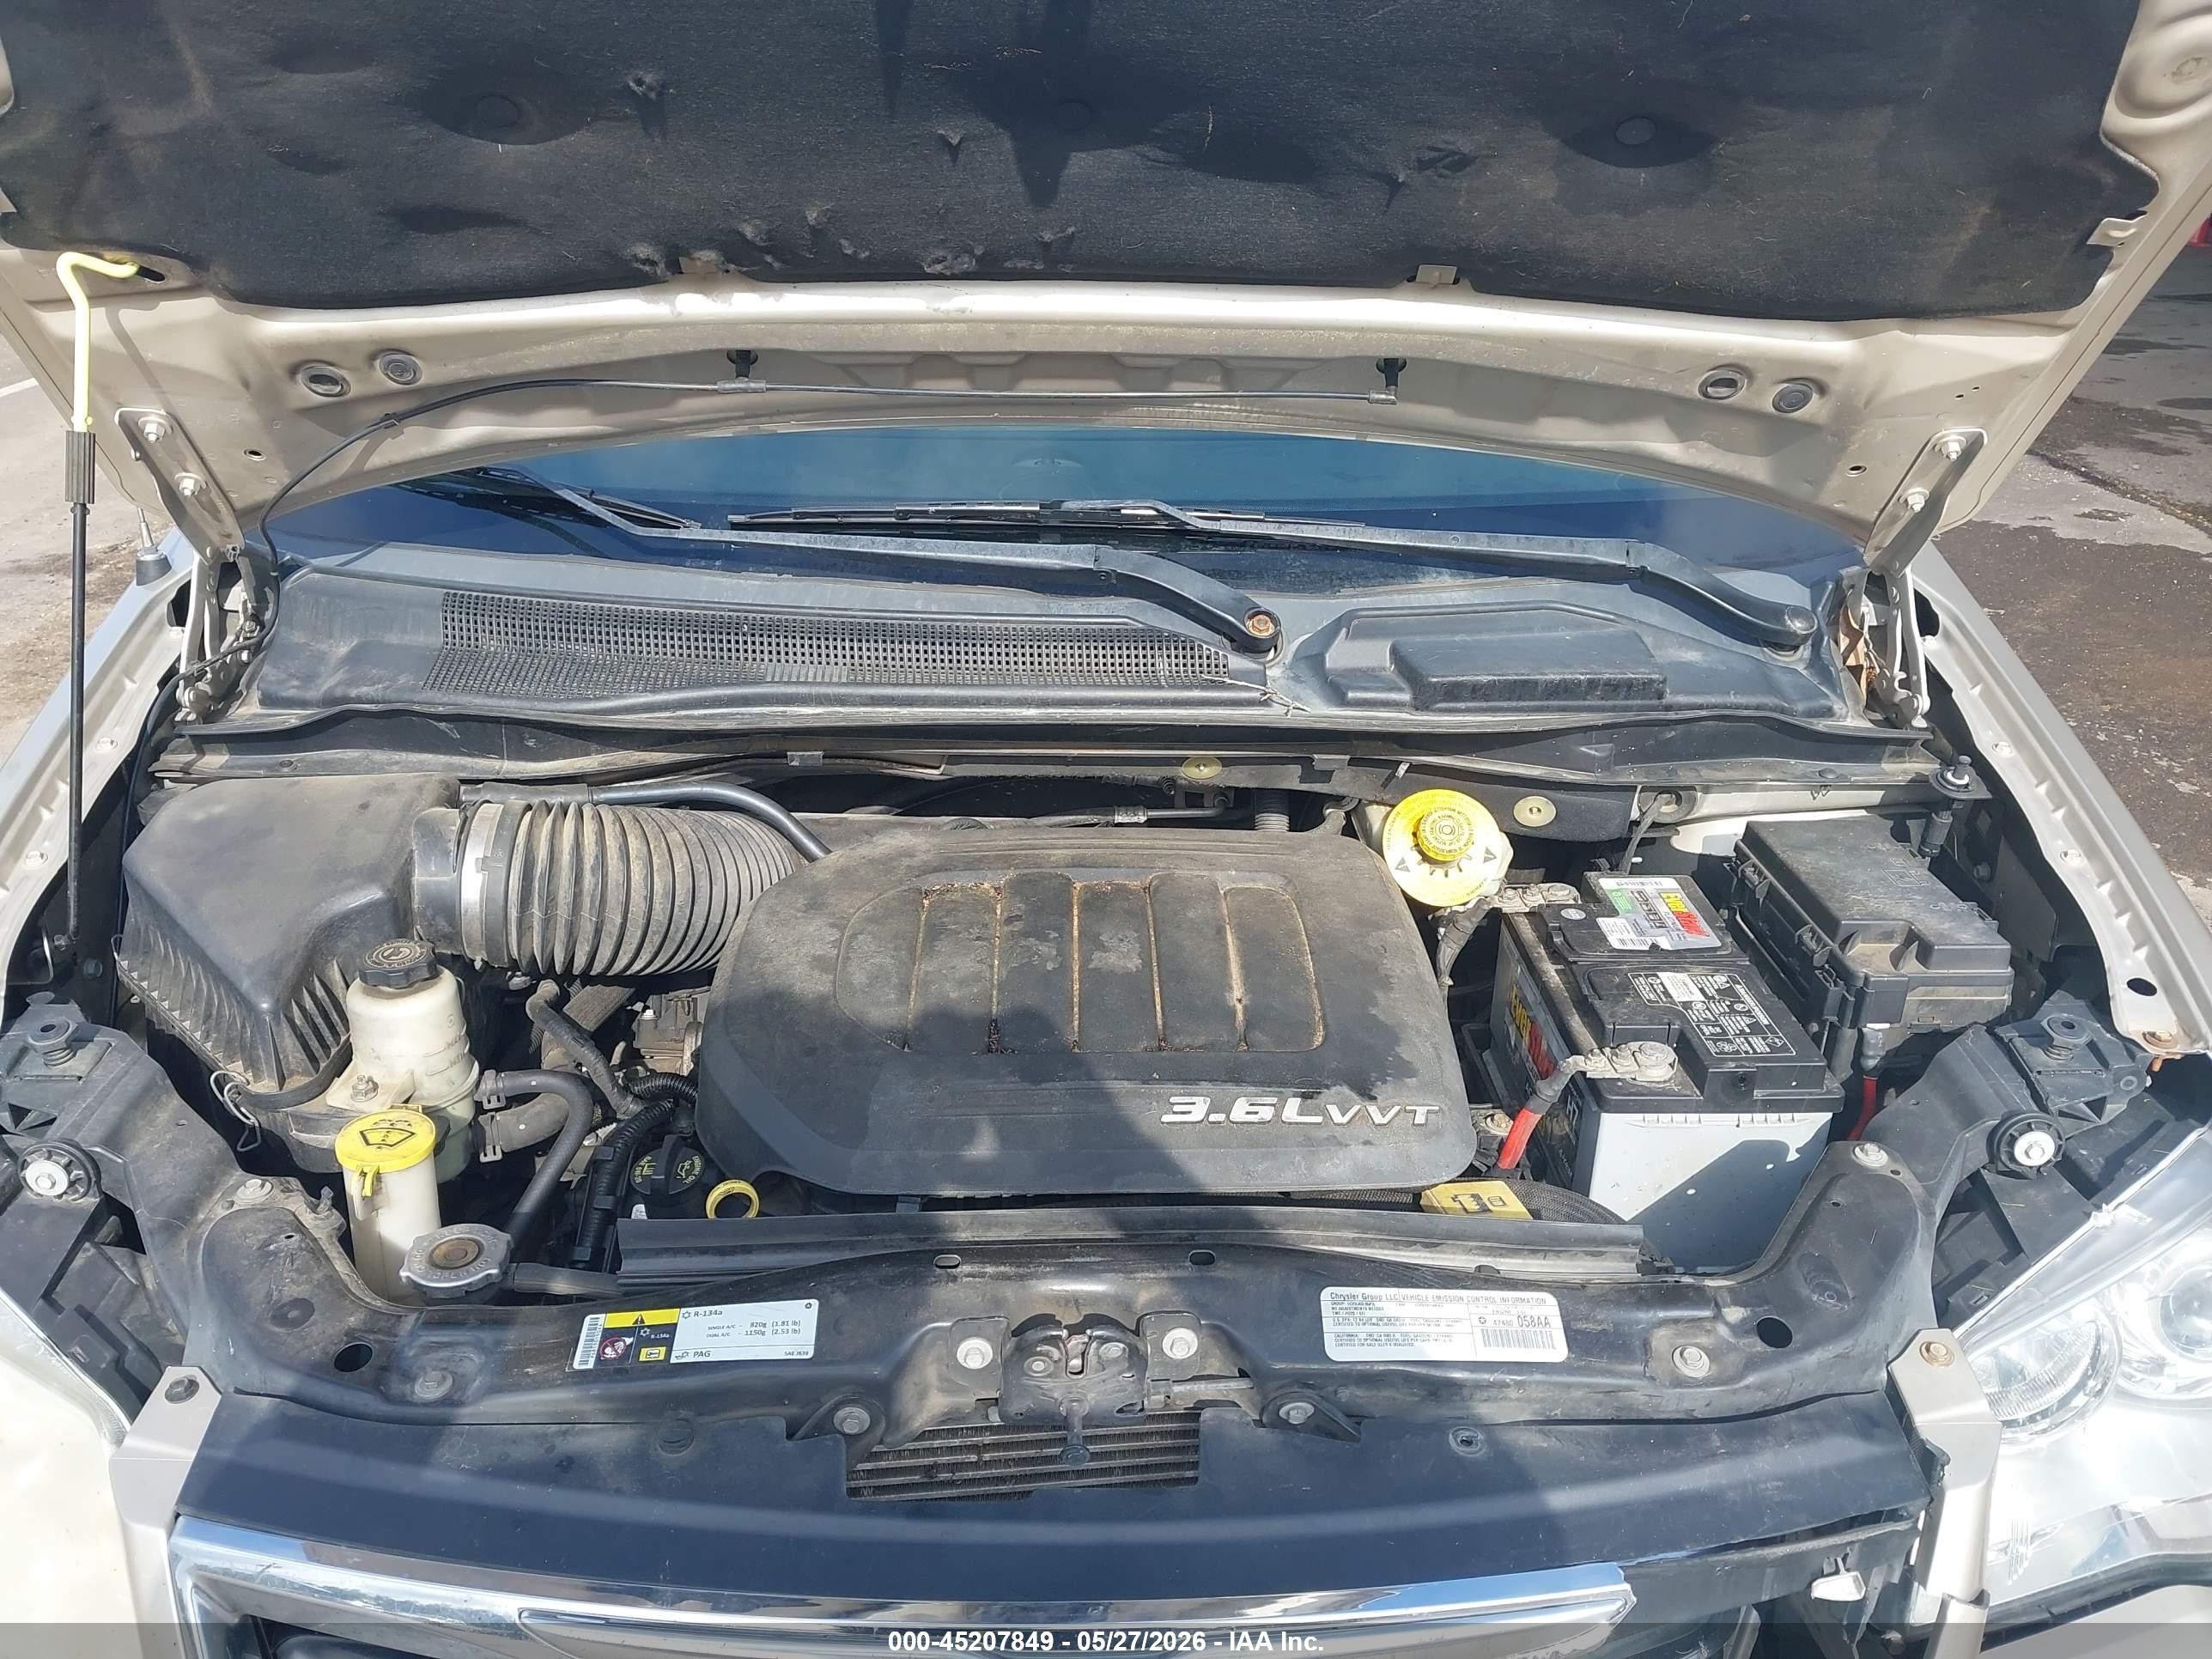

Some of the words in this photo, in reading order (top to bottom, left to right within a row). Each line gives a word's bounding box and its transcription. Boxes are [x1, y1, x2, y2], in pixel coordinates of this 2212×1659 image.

[692, 1155, 702, 1175] ENGINE
[682, 1176, 696, 1184] OIL
[1330, 1292, 1359, 1300] Chrysler
[1517, 1315, 1551, 1327] 058AA
